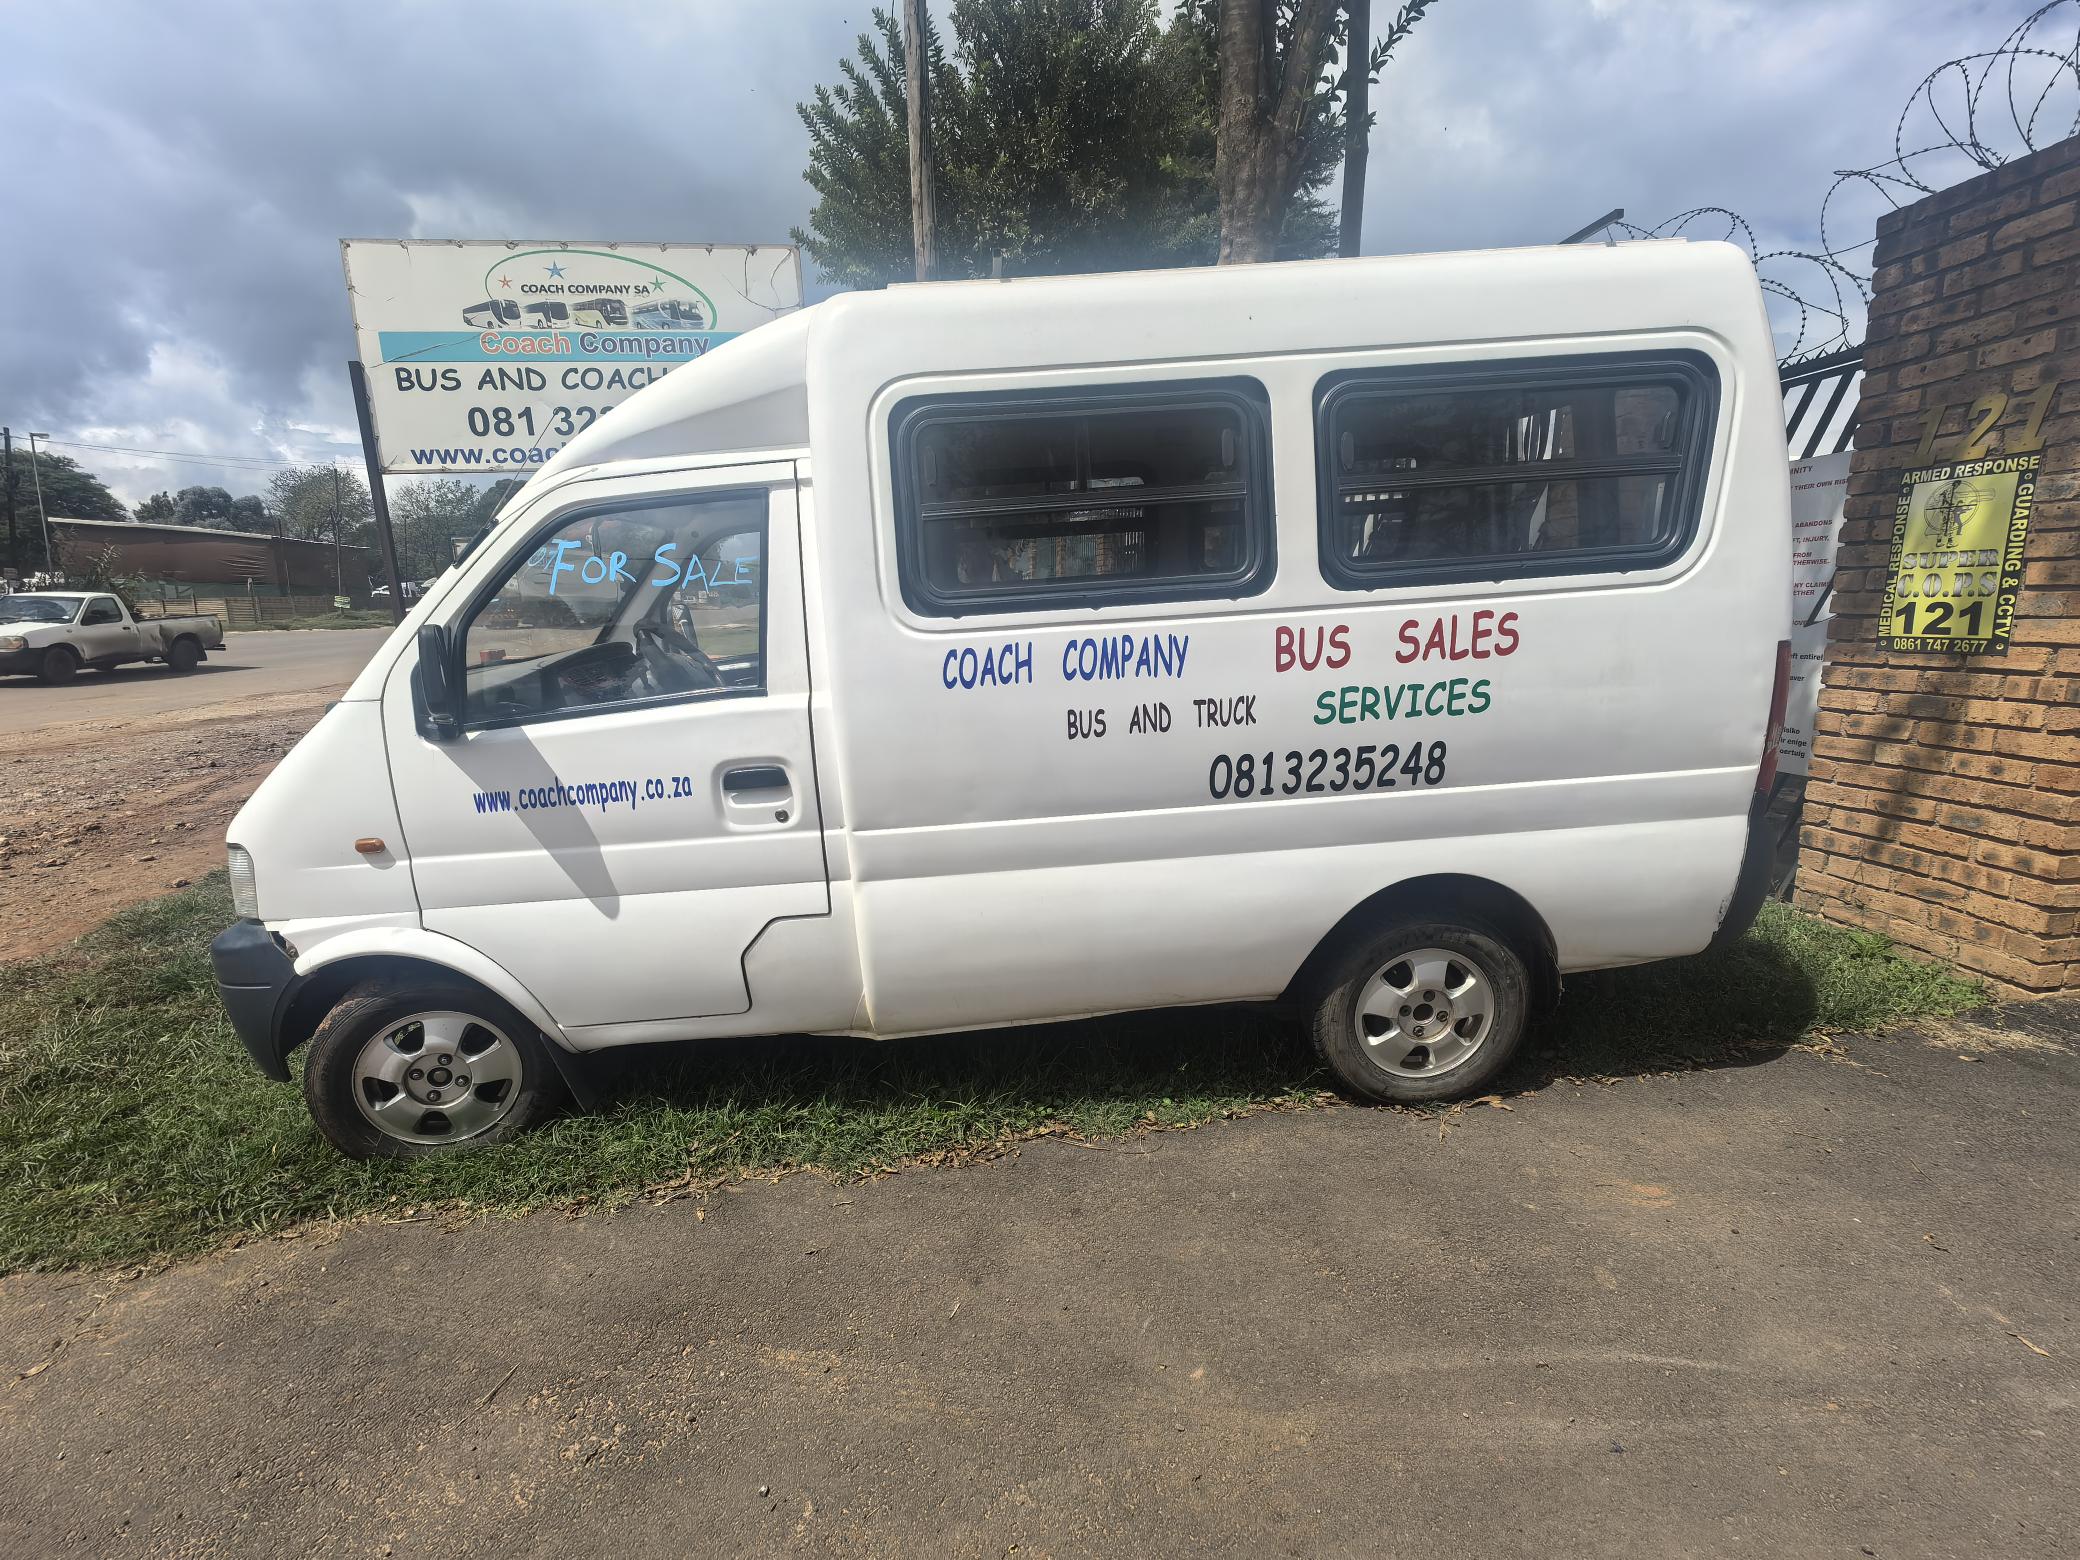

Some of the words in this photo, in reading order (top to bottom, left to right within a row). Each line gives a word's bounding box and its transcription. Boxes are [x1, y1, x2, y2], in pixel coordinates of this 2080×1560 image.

[520, 284, 565, 295] COACH
[568, 284, 631, 295] COMPANY
[634, 284, 651, 295] SA
[479, 331, 572, 355] Coach
[579, 331, 710, 359] Company
[395, 367, 462, 392] BUS
[477, 367, 547, 392] AND
[561, 366, 669, 391] COACH
[467, 405, 536, 437] 081
[1902, 382, 2060, 470] 121
[410, 441, 567, 465] www.coac
[1901, 466, 1951, 485] ARMED
[1953, 455, 2041, 479] RESPONSE
[1834, 478, 1848, 486] RIS
[2004, 483, 2035, 573] GUARDING
[549, 537, 637, 596] FOR
[651, 542, 758, 594] SALE
[1877, 575, 1899, 637] MEDICAL
[1889, 495, 1912, 572] RESPONSE
[1901, 548, 2000, 570] SUPER
[2001, 576, 2020, 589] &
[1895, 600, 1984, 636] 121
[1994, 594, 2016, 638] CCTV
[942, 641, 1034, 690] COACH
[1062, 634, 1189, 682] COMPANY
[1275, 624, 1352, 674] BUS
[1395, 609, 1520, 664] SALES
[1893, 637, 1922, 651] 0861
[1926, 638, 1949, 652] 747
[1953, 640, 1988, 653] 2677
[1067, 708, 1107, 741] BUS
[1129, 702, 1173, 735] AND
[1193, 694, 1258, 728] TRUCK
[1313, 677, 1492, 726] SERVICES
[1208, 740, 1448, 800] 0813235248
[472, 775, 694, 815] www.coachcompany.co.za
